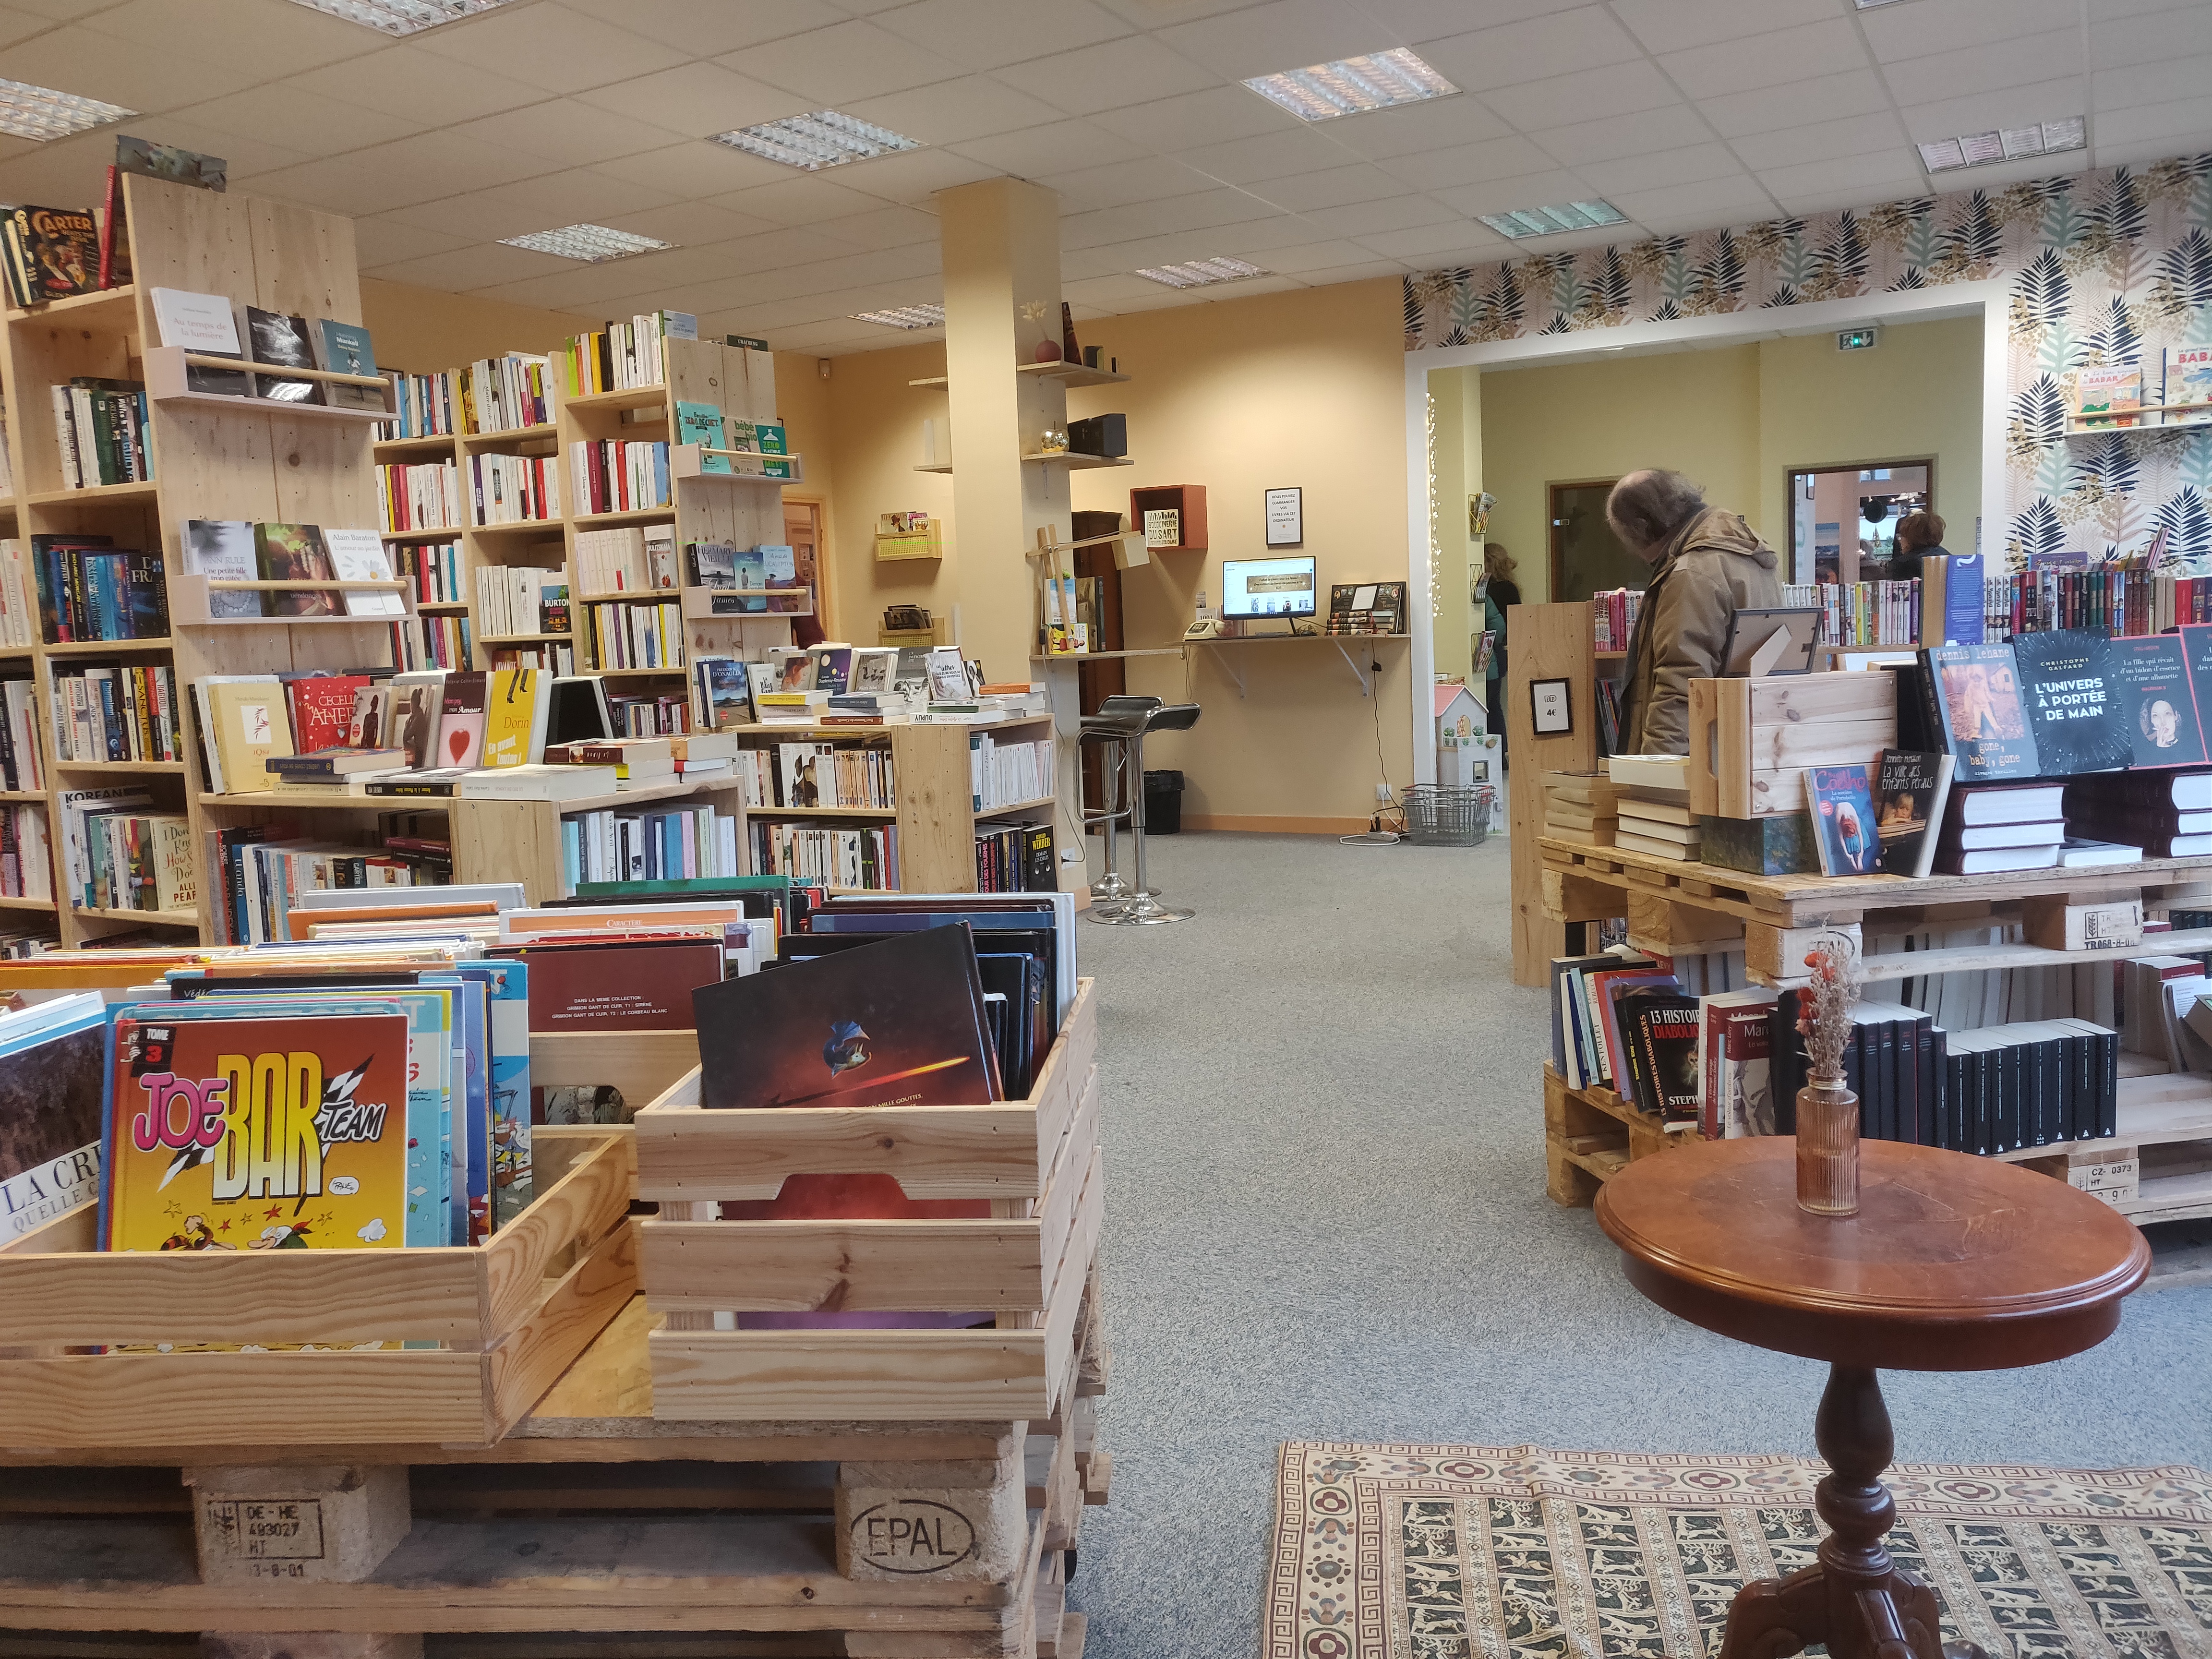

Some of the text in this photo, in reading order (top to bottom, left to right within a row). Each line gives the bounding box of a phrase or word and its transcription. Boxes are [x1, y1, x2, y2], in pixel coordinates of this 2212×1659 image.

[32, 211, 93, 239] CARTER
[174, 317, 185, 325] Au
[188, 320, 214, 330] temps
[336, 337, 359, 347] Mankell
[734, 420, 754, 432] bébé
[745, 431, 757, 441] bio
[1148, 520, 1177, 529] BOUQUINERIE
[1149, 529, 1177, 540] DU SART
[697, 545, 731, 555] HERMARY
[218, 567, 235, 576] petite
[544, 599, 569, 608] BURTON
[712, 596, 735, 605] James
[1936, 647, 2010, 661] dennis lehane
[2040, 657, 2090, 667] CHRISTOPHE
[2048, 662, 2084, 672] GALFARD
[2146, 658, 2157, 667] qui
[2158, 656, 2175, 664] rêvait
[2120, 664, 2181, 674] d'un bidon d'essence
[2148, 673, 2179, 681] allumette
[2035, 677, 2104, 695] L'UNIVERS
[102, 681, 115, 716] Chameleon
[156, 684, 166, 711] RAGDOLL
[318, 695, 354, 706] CECELI
[1544, 695, 1557, 703] BD
[2038, 688, 2107, 707] À PORTÉE
[458, 706, 482, 714] Amour
[1546, 708, 1557, 718] 4€
[2045, 704, 2103, 721] DE MAIN
[504, 716, 529, 729] Dorin
[488, 734, 516, 755] En avant
[1978, 742, 2005, 754] gone,
[252, 748, 270, 757] 1Q84
[497, 752, 518, 765] toutes
[1970, 754, 2020, 767] baby, gone
[1883, 765, 1921, 778] La des
[1815, 769, 1866, 793] Coelho
[1882, 776, 1934, 790] enfants perdus
[65, 789, 122, 804] KOREAN
[1032, 837, 1050, 851] WERBER
[1589, 978, 1598, 1004] REBECCA
[1650, 1010, 1661, 1024] 13
[146, 1027, 169, 1042] TOME
[145, 1046, 162, 1063] 3
[1640, 1014, 1665, 1106] DIABOLIQUES HISTOIRES
[1632, 1058, 1641, 1080] Stephen
[878, 1093, 923, 1108] MILLE GOUTTES,
[133, 1071, 231, 1152] JOE
[212, 1051, 325, 1201] BAR
[321, 1098, 387, 1144] TEAM
[2112, 1164, 2132, 1173] 0373
[0, 1174, 49, 1215] LA
[13, 1189, 82, 1233] QUELLE
[867, 1517, 957, 1558] EPAL
